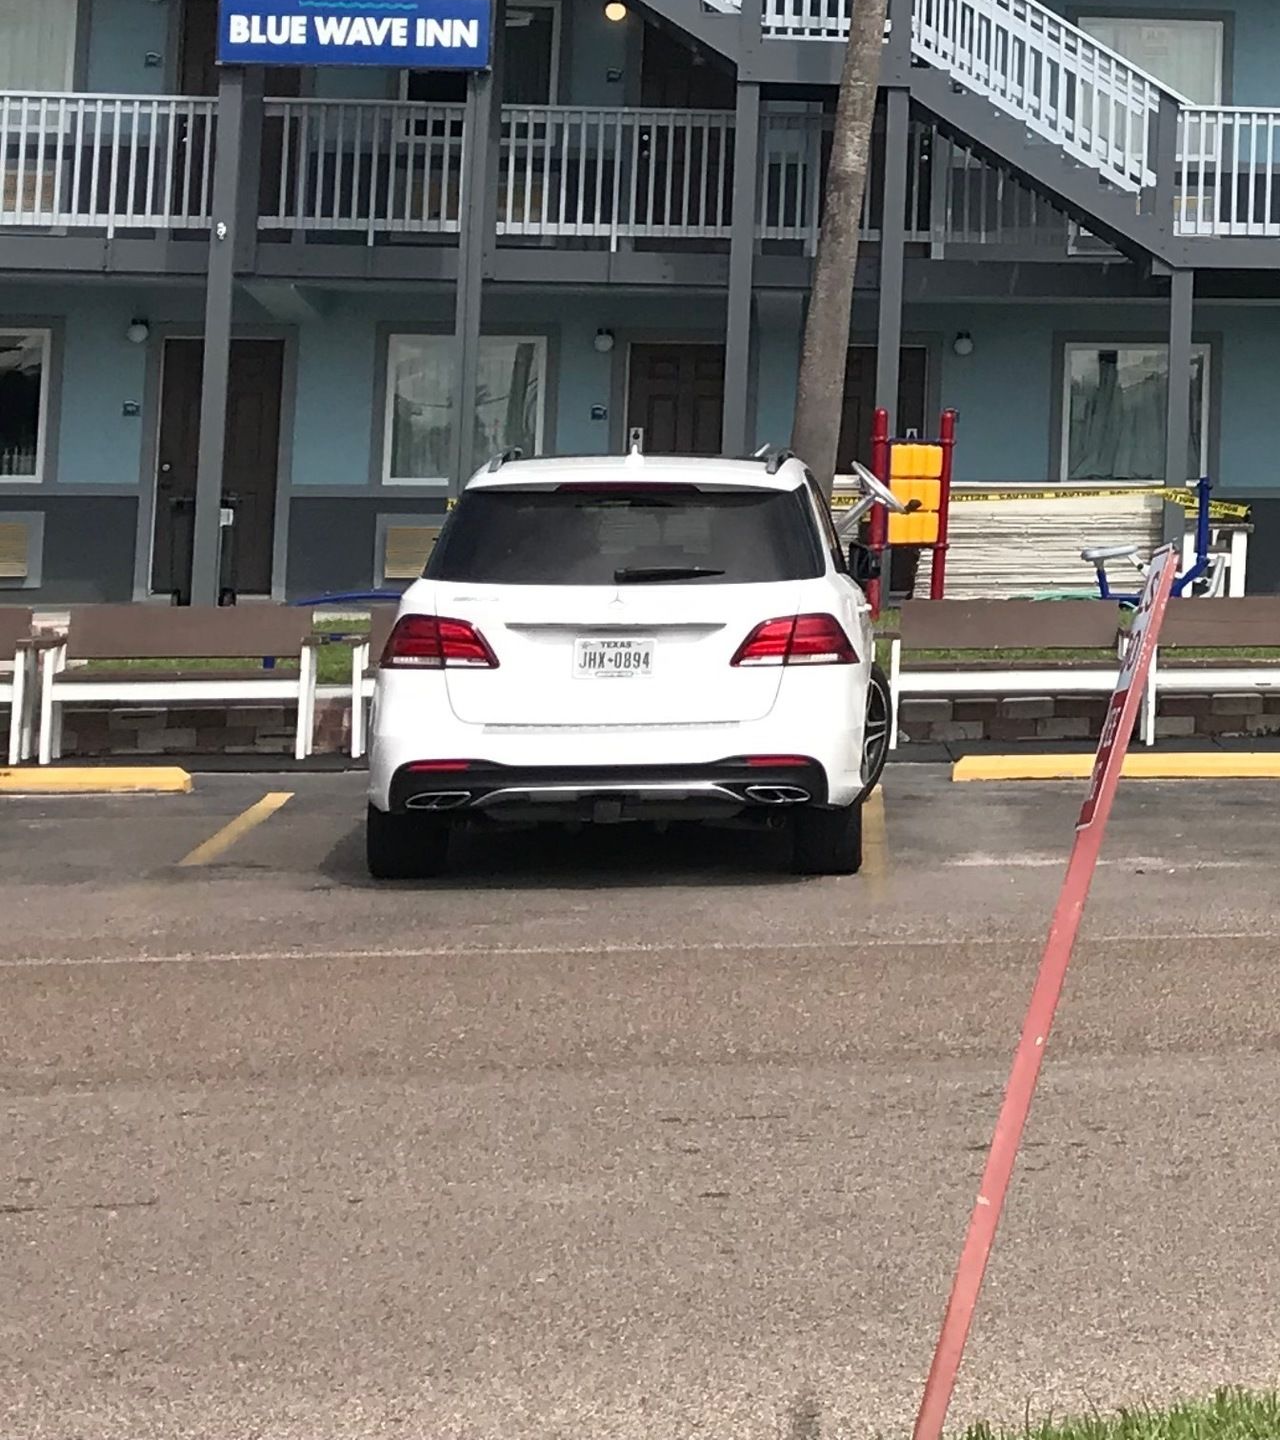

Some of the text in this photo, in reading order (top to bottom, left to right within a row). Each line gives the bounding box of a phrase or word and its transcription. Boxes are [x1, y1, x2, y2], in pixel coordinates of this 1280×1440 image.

[229, 14, 479, 48] BLUE WAVE INN
